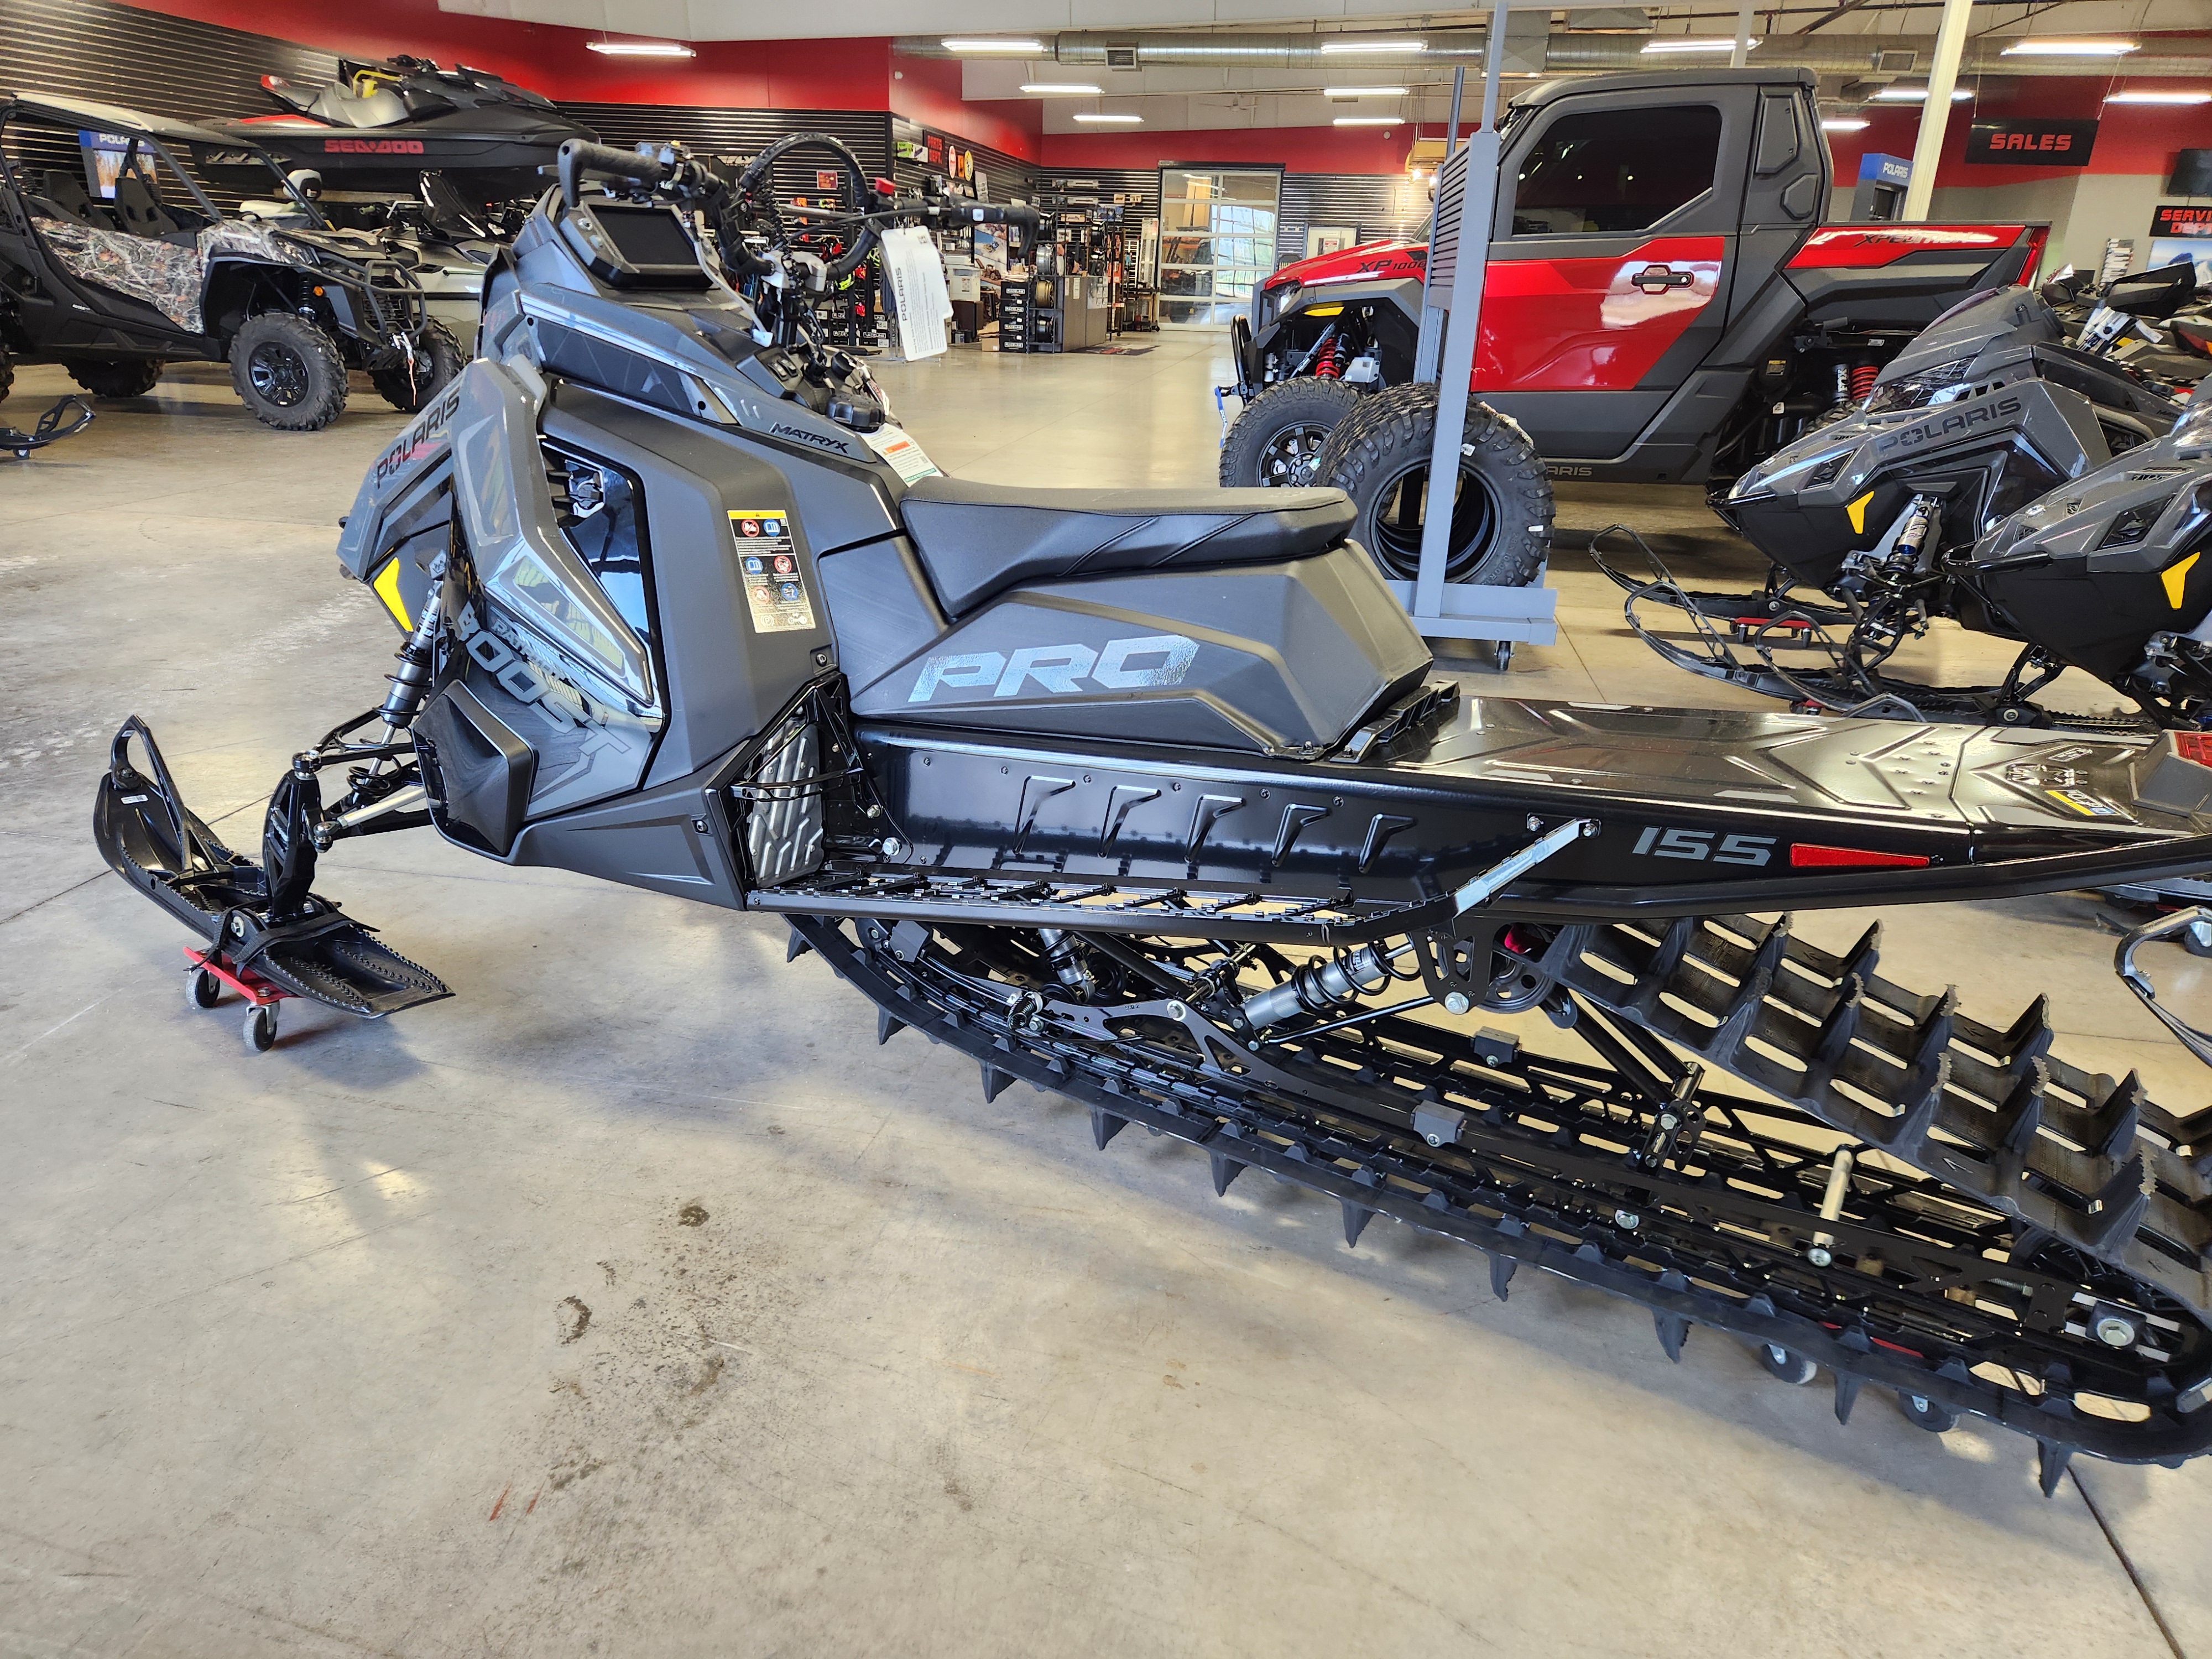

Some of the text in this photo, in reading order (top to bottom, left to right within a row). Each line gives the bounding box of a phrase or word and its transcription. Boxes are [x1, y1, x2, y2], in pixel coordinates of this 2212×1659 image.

[99, 134, 145, 147] POLAS
[927, 135, 942, 151] PARTS
[1990, 133, 2072, 151] SALES
[1882, 162, 1909, 179] POLARIS
[2159, 208, 2212, 221] SERVI
[1356, 259, 1426, 273] XP 1000
[894, 267, 907, 321] POLARIS
[1837, 368, 1848, 392] FOX
[373, 386, 460, 490] POLARIS
[769, 421, 849, 454] MATRYX
[1875, 397, 2022, 453] POLARIS
[1547, 466, 1592, 476] ARIS
[491, 619, 568, 682] PATRIOT
[457, 600, 632, 757] BOOST
[907, 635, 1200, 702] PRO
[1631, 827, 1778, 867] 155
